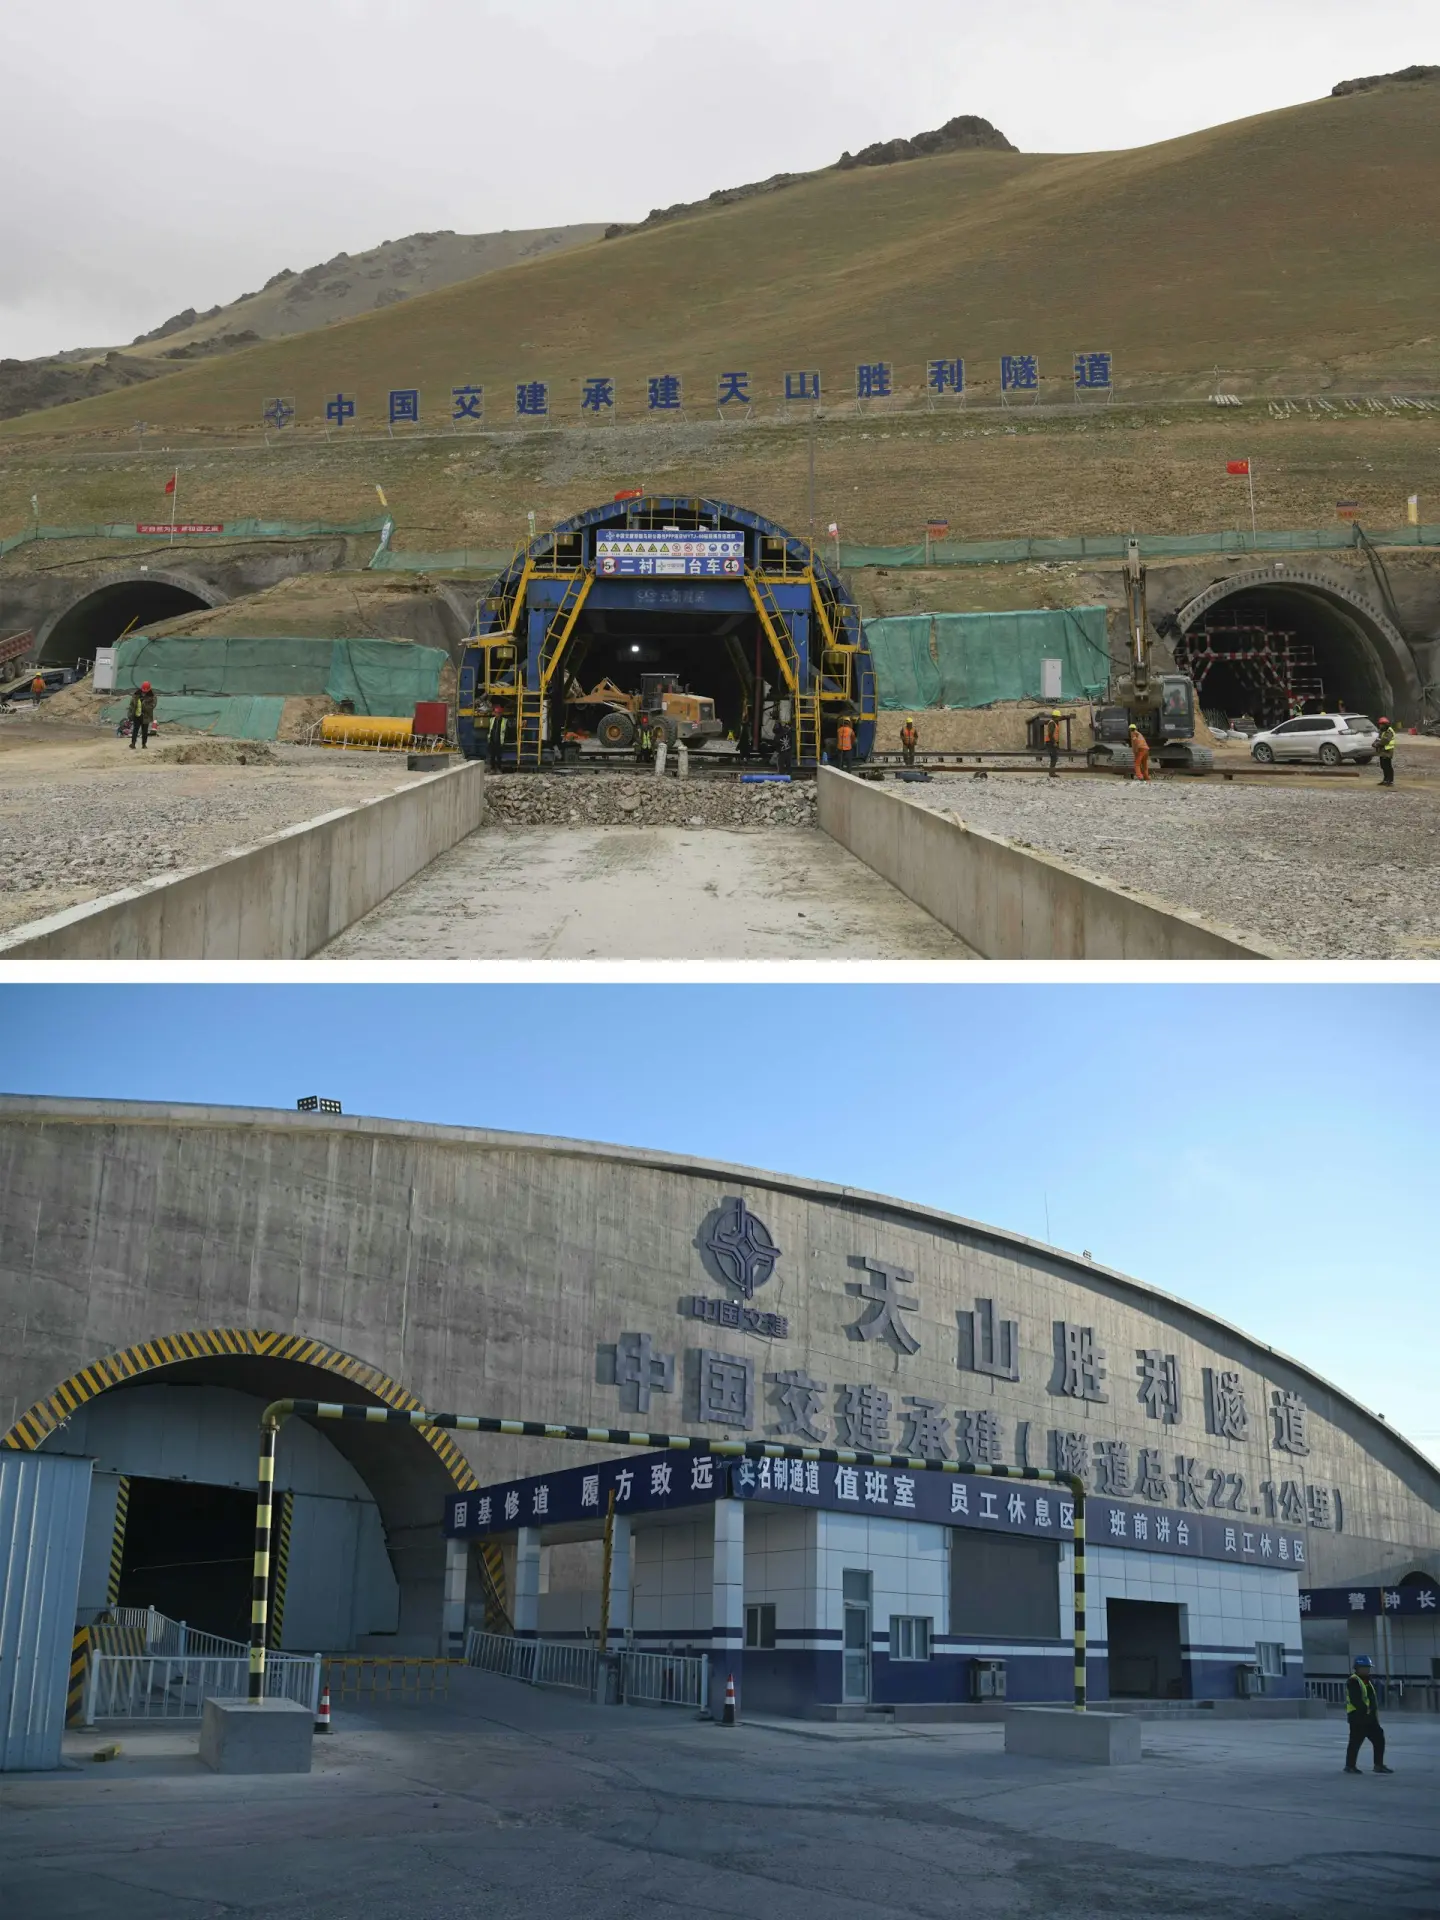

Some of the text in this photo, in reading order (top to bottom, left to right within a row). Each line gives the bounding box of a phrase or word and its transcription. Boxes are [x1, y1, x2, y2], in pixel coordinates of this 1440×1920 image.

[326, 353, 1111, 426] 中国交建承建天山胜利隧道
[620, 558, 721, 574] 二衬 台车
[692, 1295, 789, 1339] 中国交建
[857, 1255, 1310, 1457] 天山胜利隧道
[453, 1456, 714, 1529] 固基修道 履方致远
[739, 1455, 1306, 1562] 实名制通道 值班室 员工休息区 班前讲台 员工休息区
[1348, 1590, 1436, 1610] 警钟长
